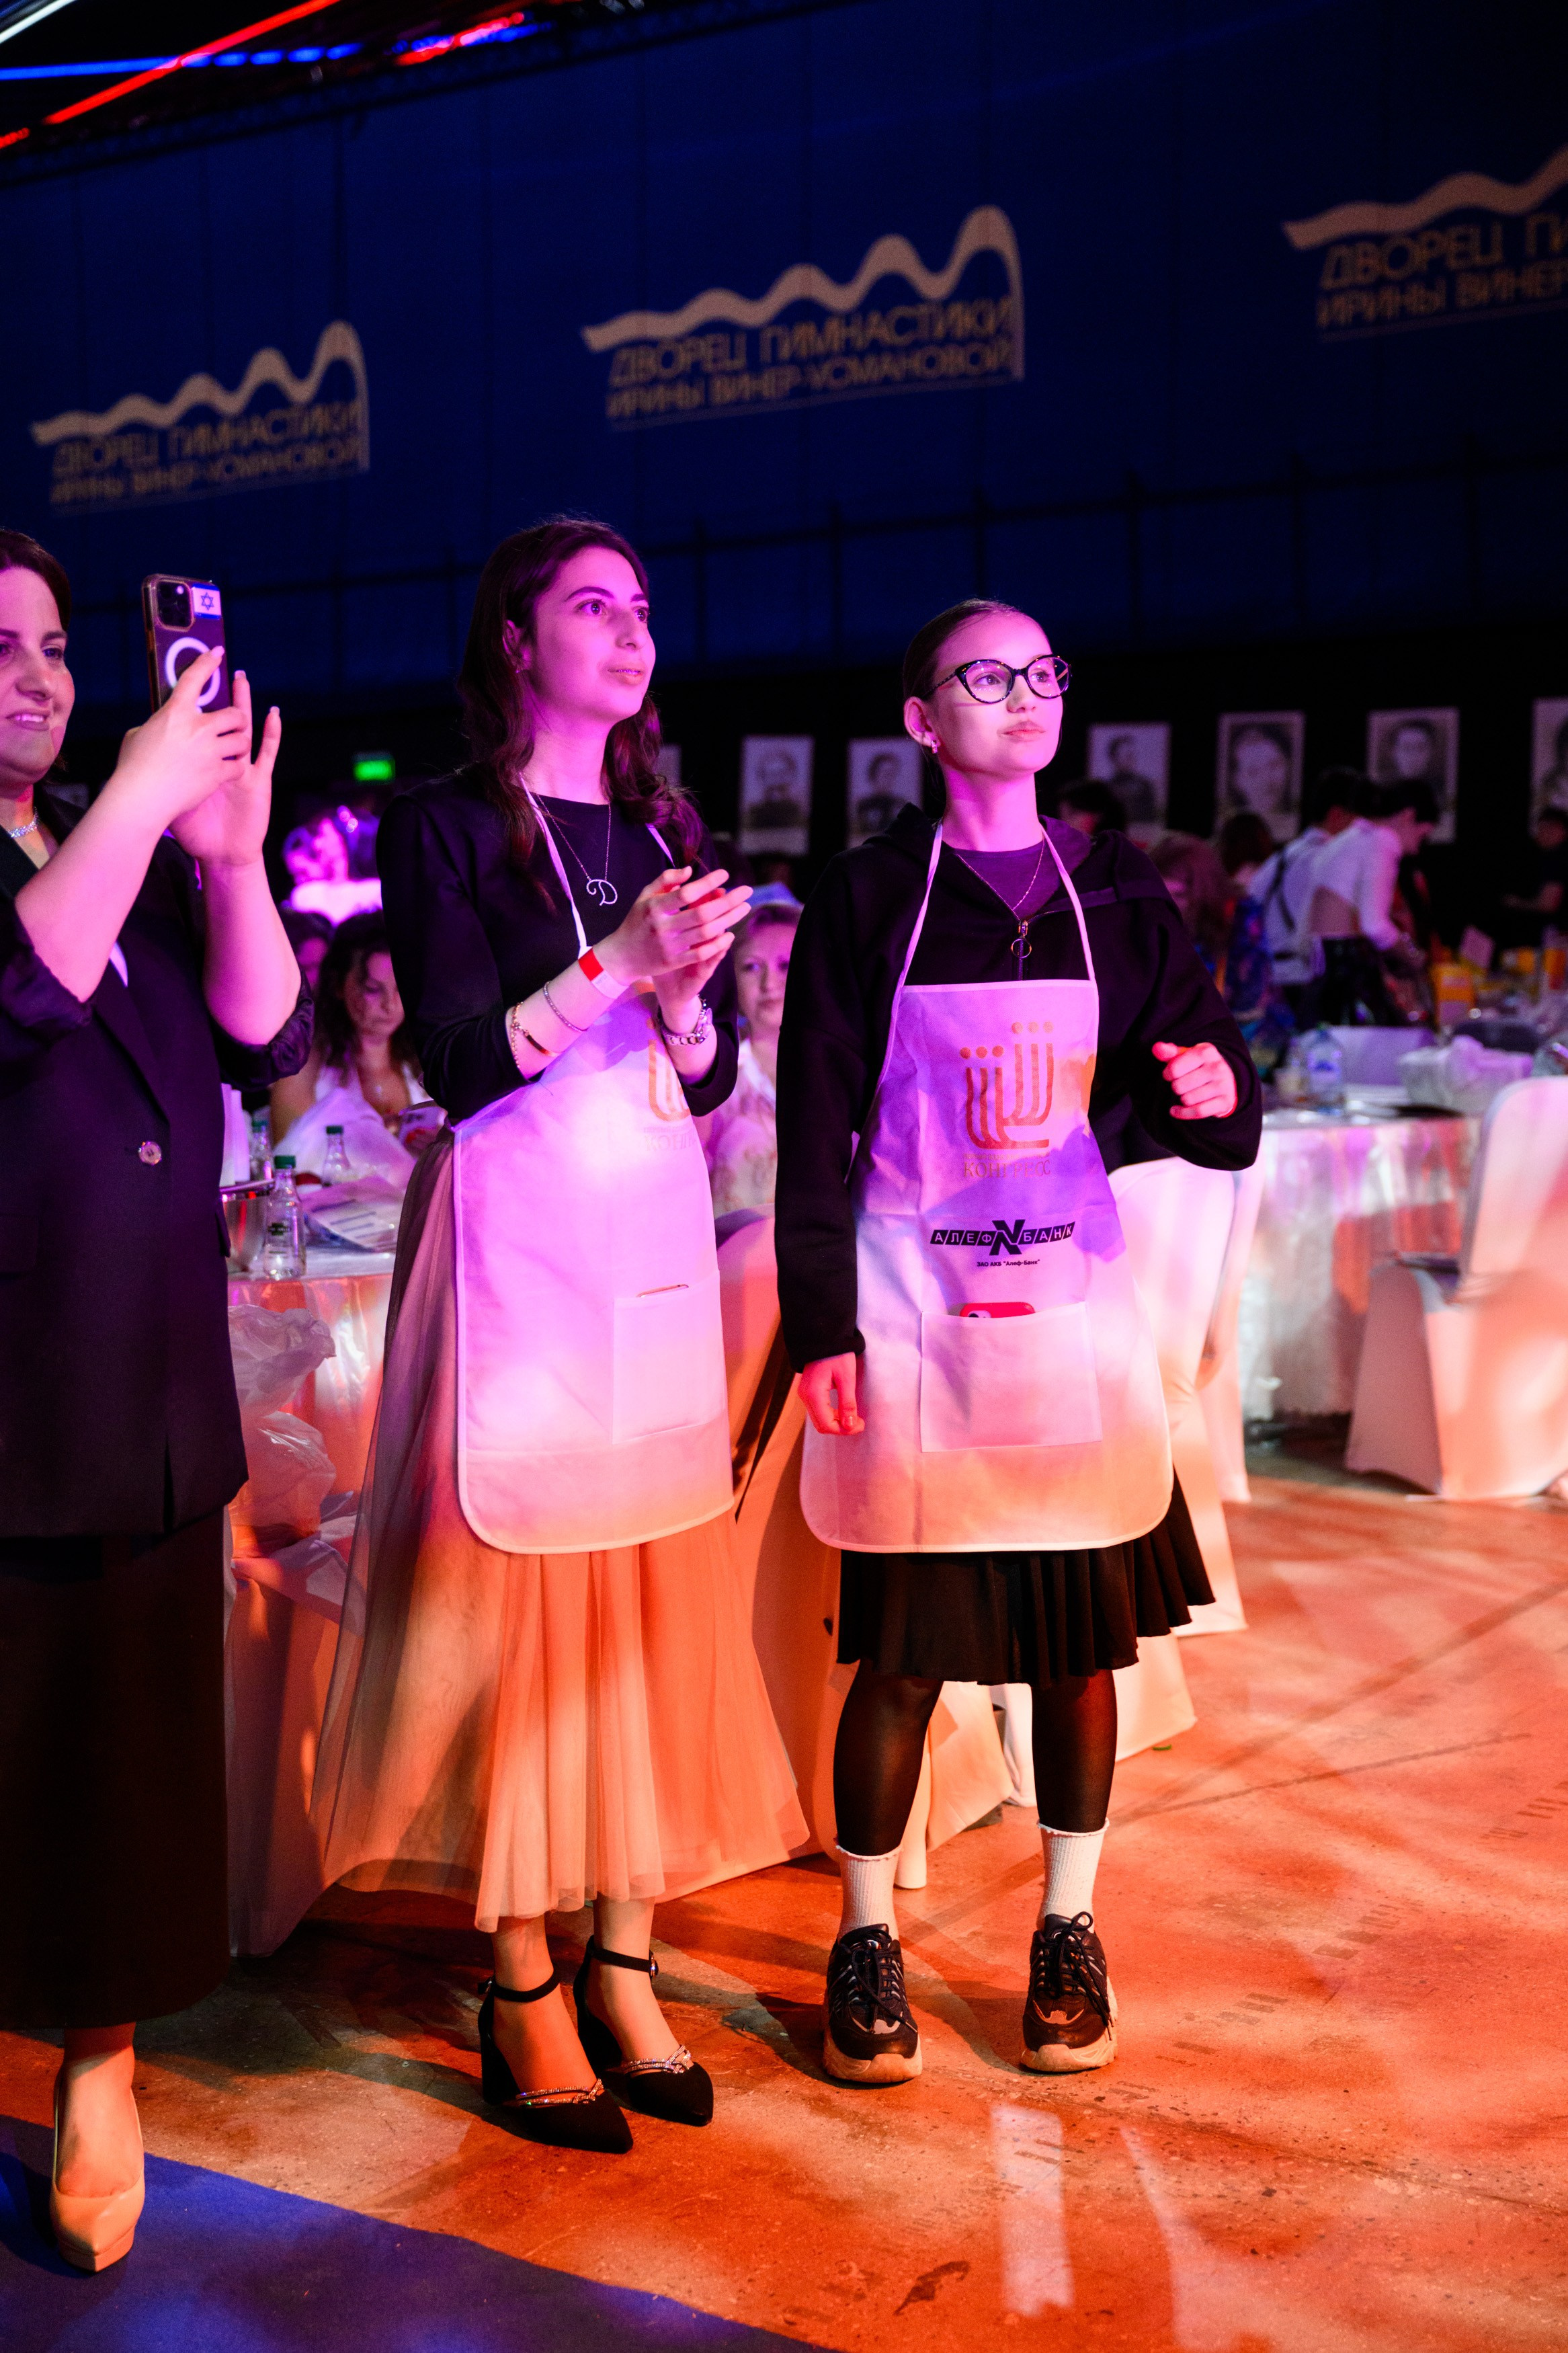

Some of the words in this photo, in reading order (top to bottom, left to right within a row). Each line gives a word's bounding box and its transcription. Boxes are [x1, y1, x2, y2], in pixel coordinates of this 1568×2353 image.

[1319, 221, 1504, 291] ДВОРЕЦ
[608, 332, 747, 389] ДВОРЕЦ
[963, 1160, 1051, 1178] КОНГРЕСС
[932, 1231, 994, 1244] АЛЕФ
[1022, 1224, 1073, 1243] БАНК
[1003, 1259, 1040, 1267] "Алеф-Банк"
